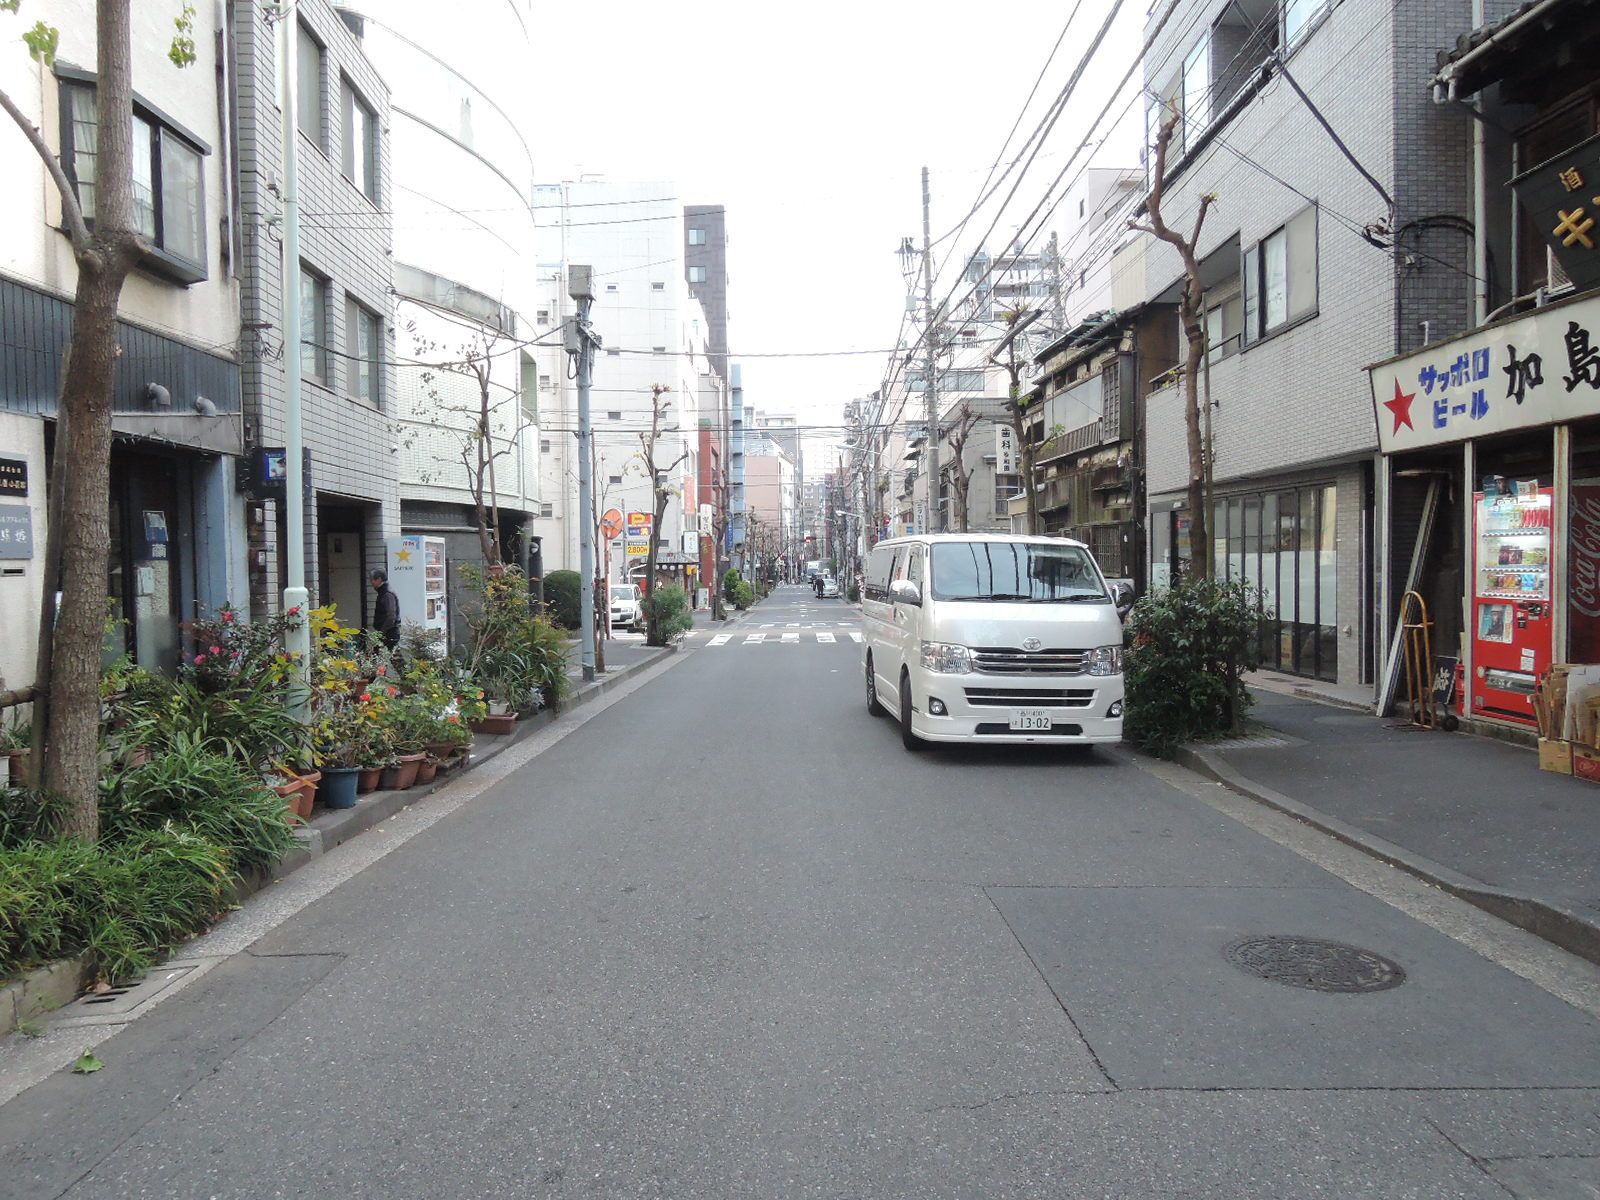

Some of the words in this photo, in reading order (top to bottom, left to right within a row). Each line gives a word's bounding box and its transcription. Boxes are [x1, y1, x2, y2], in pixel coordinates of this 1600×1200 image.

[1552, 196, 1600, 250] キ
[1418, 346, 1491, 396] サッポロ
[1433, 388, 1490, 429] ビール
